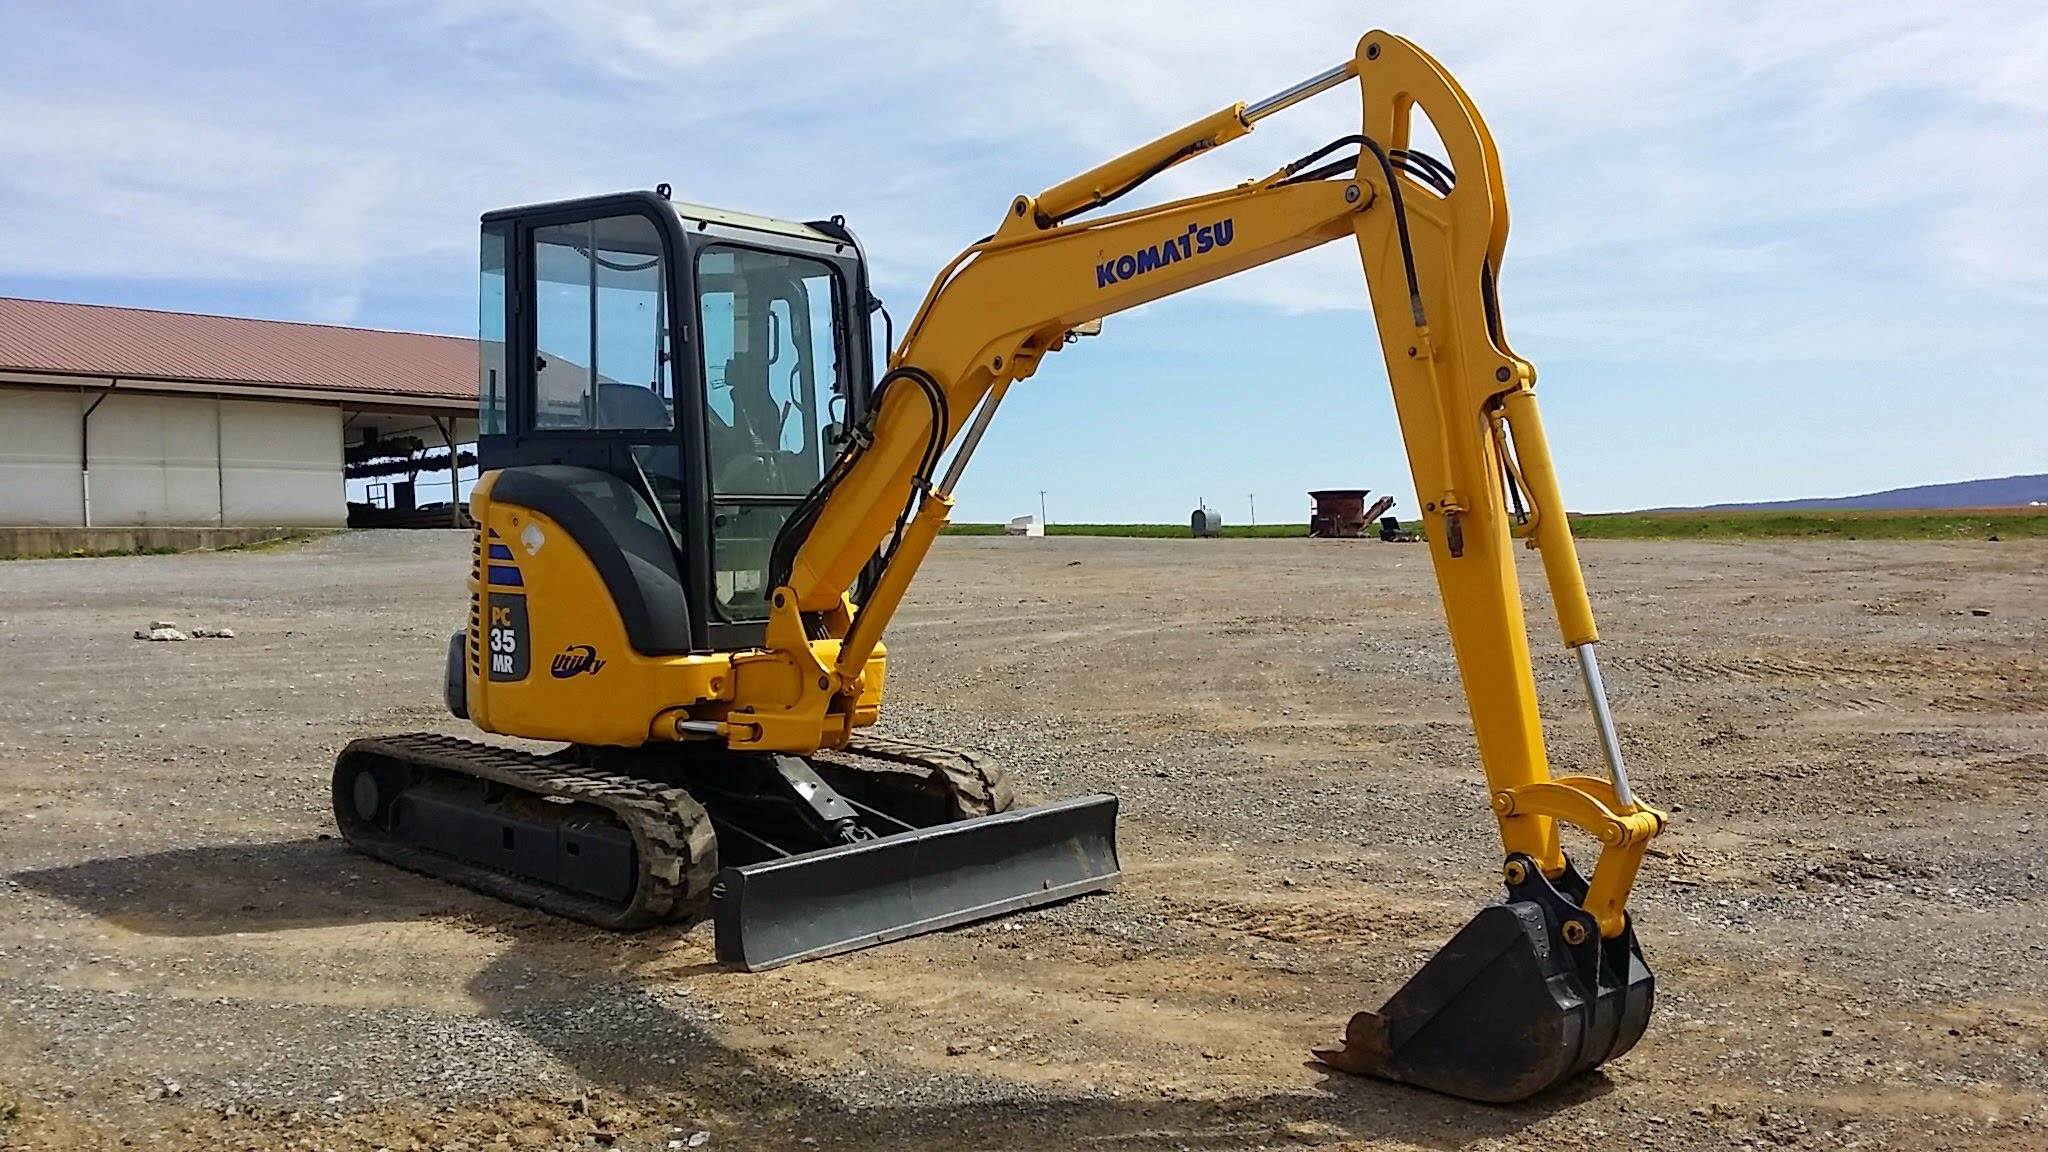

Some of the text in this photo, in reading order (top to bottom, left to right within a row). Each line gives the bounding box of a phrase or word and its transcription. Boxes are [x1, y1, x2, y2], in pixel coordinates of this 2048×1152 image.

[1096, 218, 1234, 288] KOMATSU
[492, 606, 511, 627] PC
[490, 628, 516, 653] 35
[492, 653, 513, 674] MR
